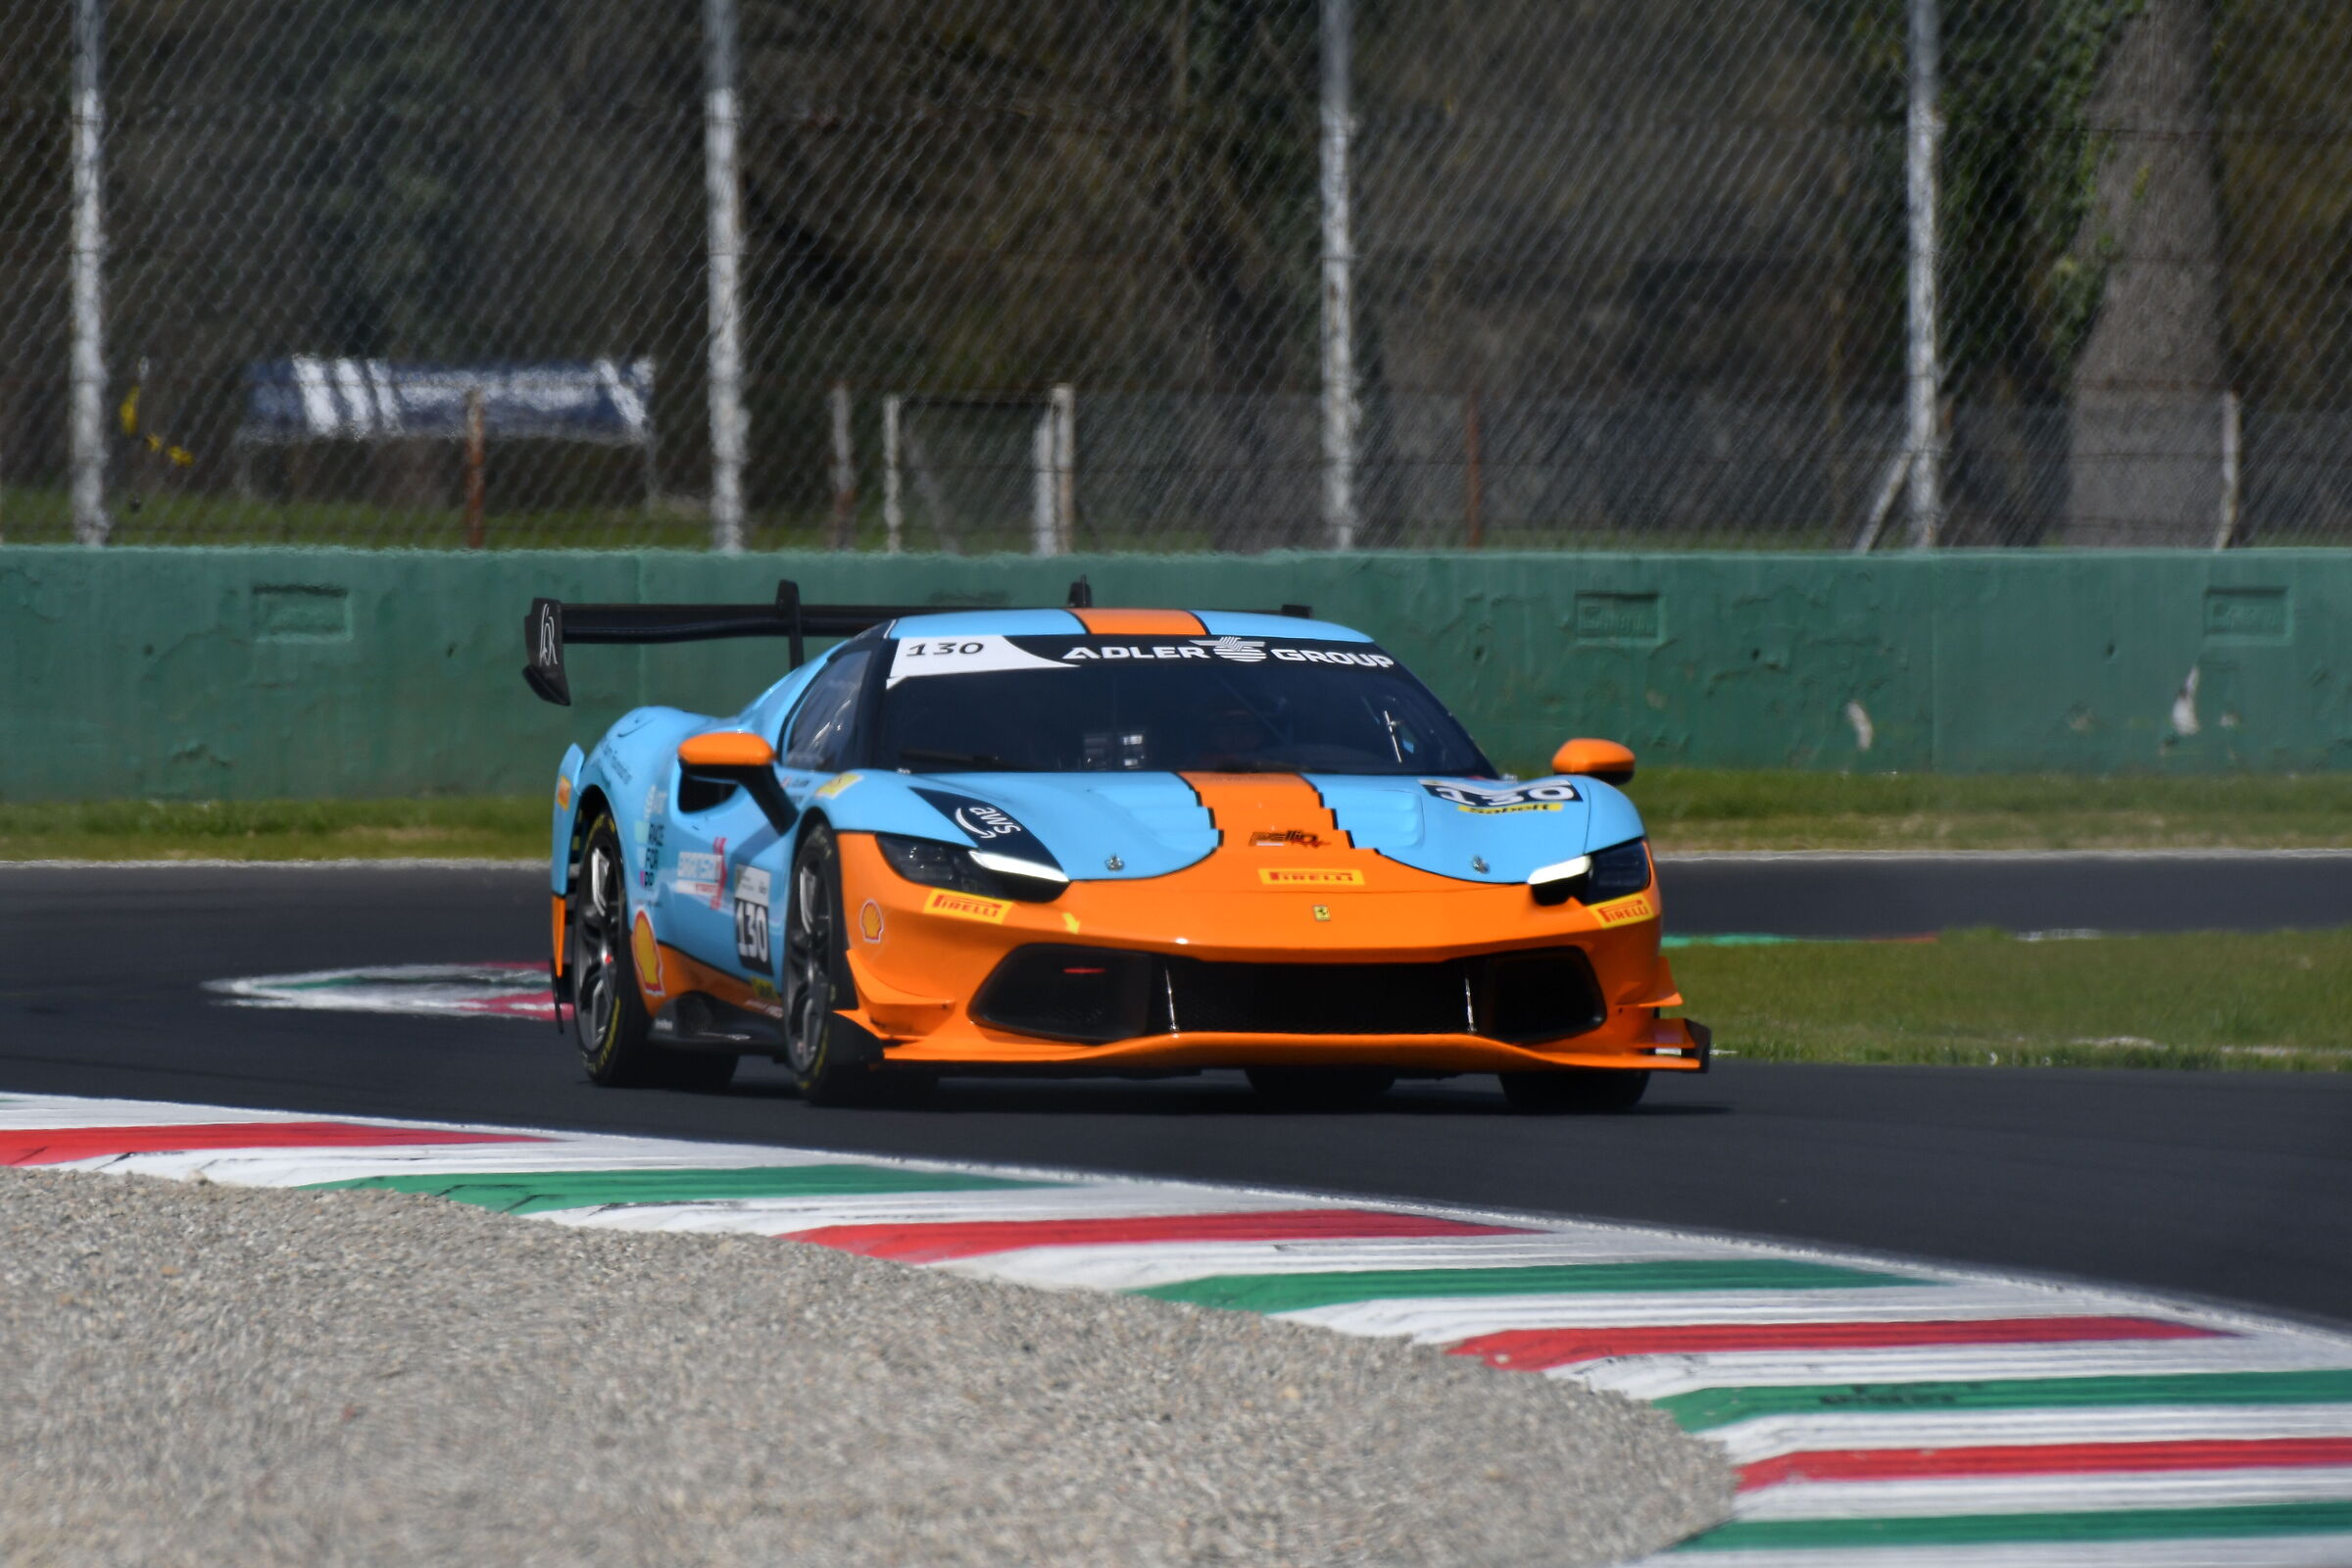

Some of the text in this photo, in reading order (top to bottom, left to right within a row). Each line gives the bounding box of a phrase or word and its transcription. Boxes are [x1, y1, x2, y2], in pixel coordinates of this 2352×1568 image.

[906, 642, 985, 658] 130
[1061, 646, 1395, 669] ADLER GROUP
[1435, 785, 1575, 807] 130
[968, 807, 1021, 835] aws
[1269, 870, 1354, 882] PIRELLI
[932, 893, 1004, 918] PIRELLI
[1596, 899, 1650, 923] PIRELLI
[735, 900, 769, 963] 130
